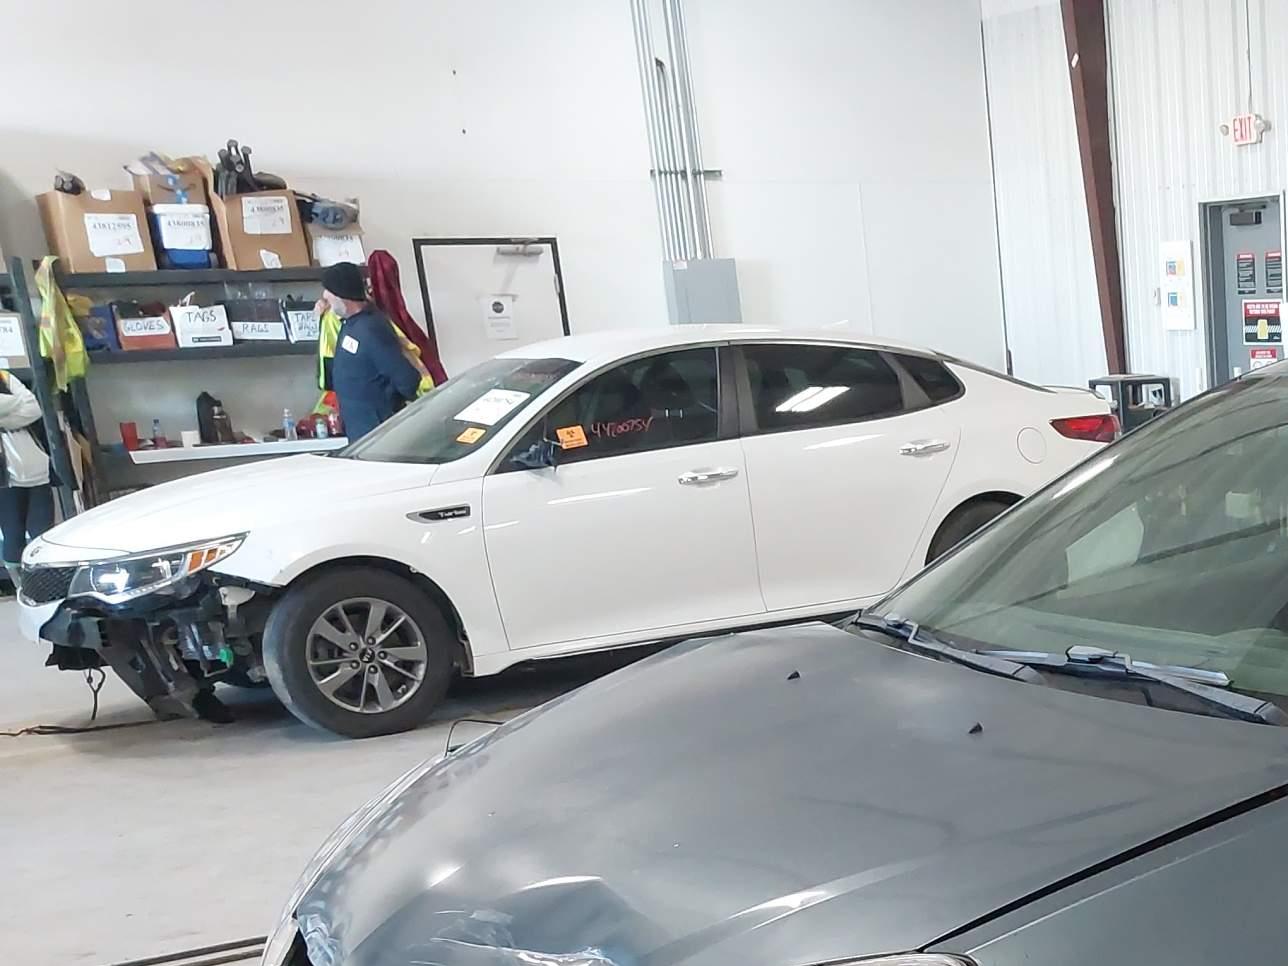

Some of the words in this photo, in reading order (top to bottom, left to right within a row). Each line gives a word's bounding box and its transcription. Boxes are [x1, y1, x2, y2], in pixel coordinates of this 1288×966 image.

[1232, 116, 1252, 142] EXIT
[186, 310, 217, 324] TAGS
[124, 319, 165, 332] GLOVES
